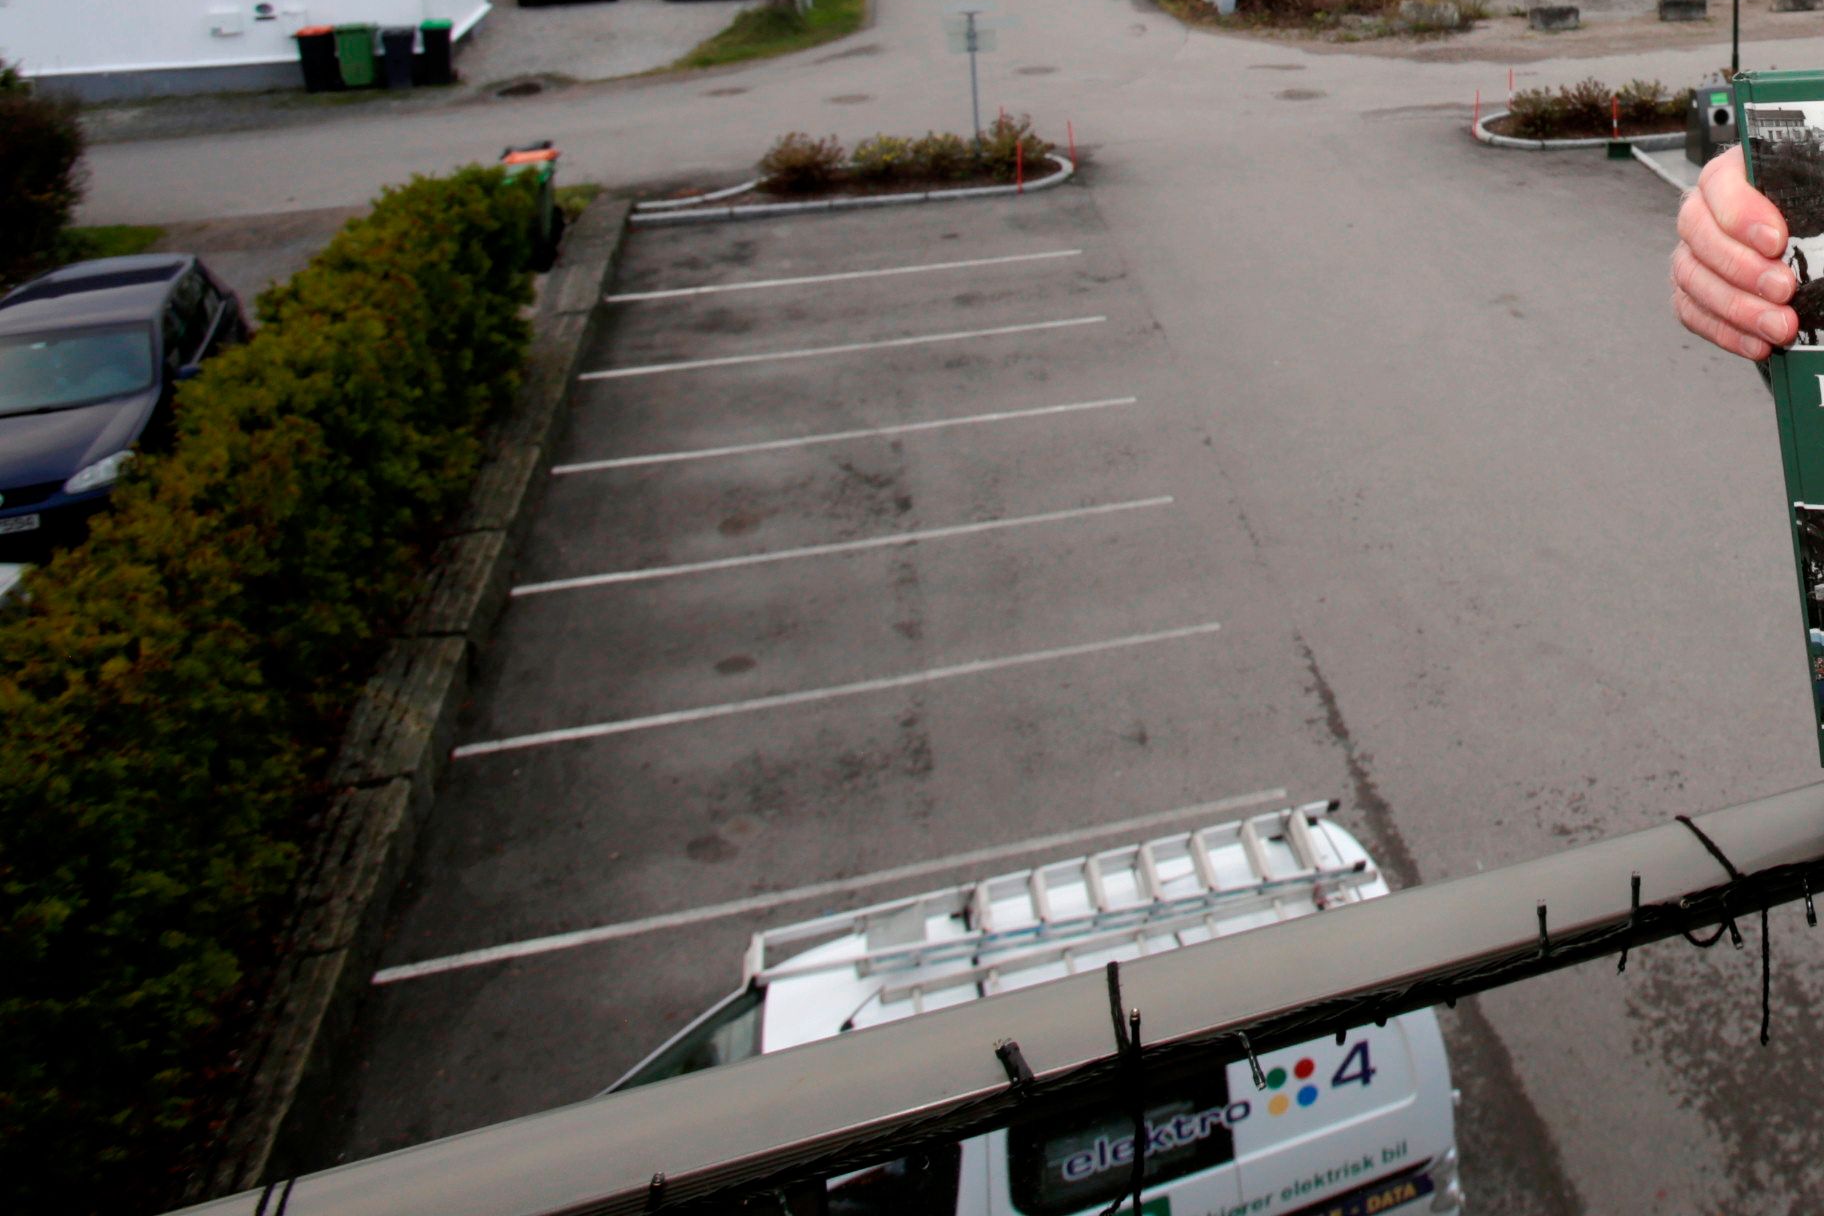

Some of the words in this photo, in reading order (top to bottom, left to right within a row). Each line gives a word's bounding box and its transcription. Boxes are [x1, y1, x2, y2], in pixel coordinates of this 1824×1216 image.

[1063, 1100, 1251, 1181] elektro
[1331, 1039, 1377, 1088] 4
[1280, 1153, 1376, 1202] elektrisk
[1381, 1139, 1409, 1164] bil
